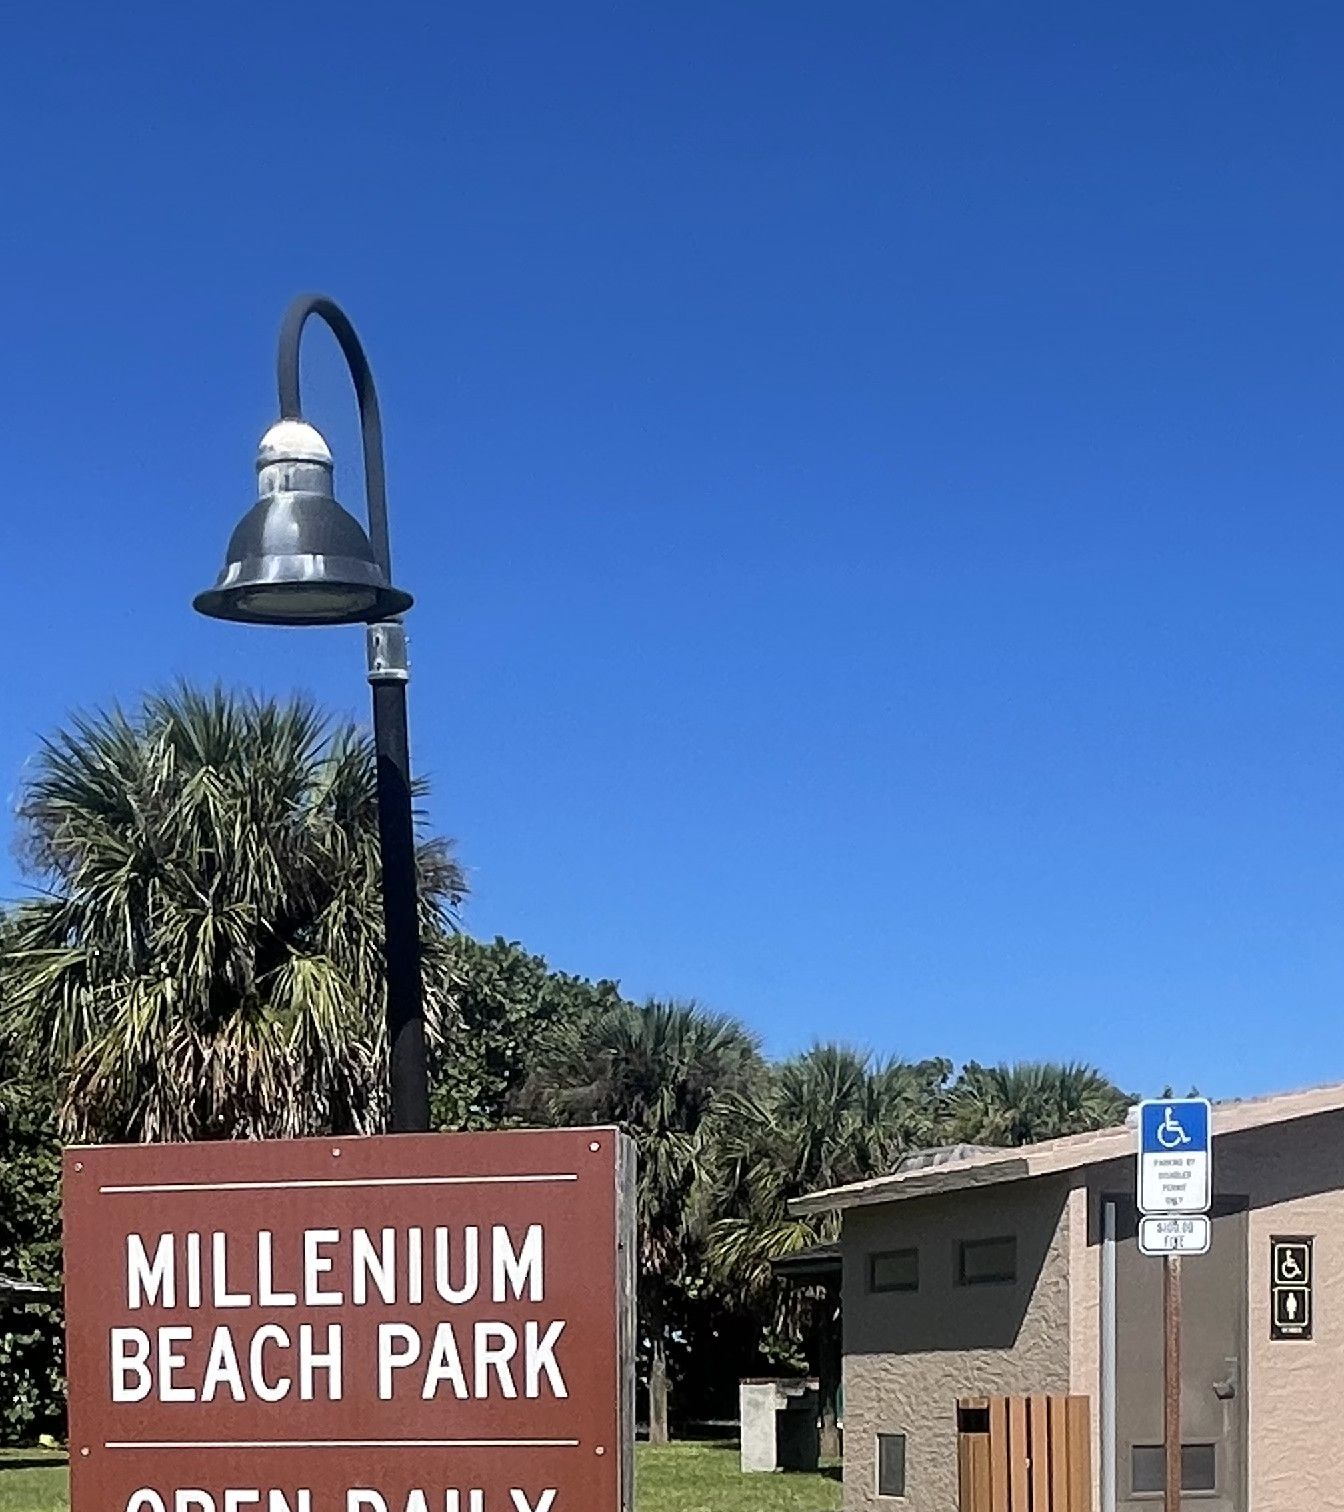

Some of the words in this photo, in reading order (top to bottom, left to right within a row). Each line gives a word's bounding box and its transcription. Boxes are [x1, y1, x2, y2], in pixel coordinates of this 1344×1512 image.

[126, 1224, 544, 1310] MILLENIUM
[111, 1323, 342, 1403] BEACH
[377, 1320, 568, 1401] PARK
